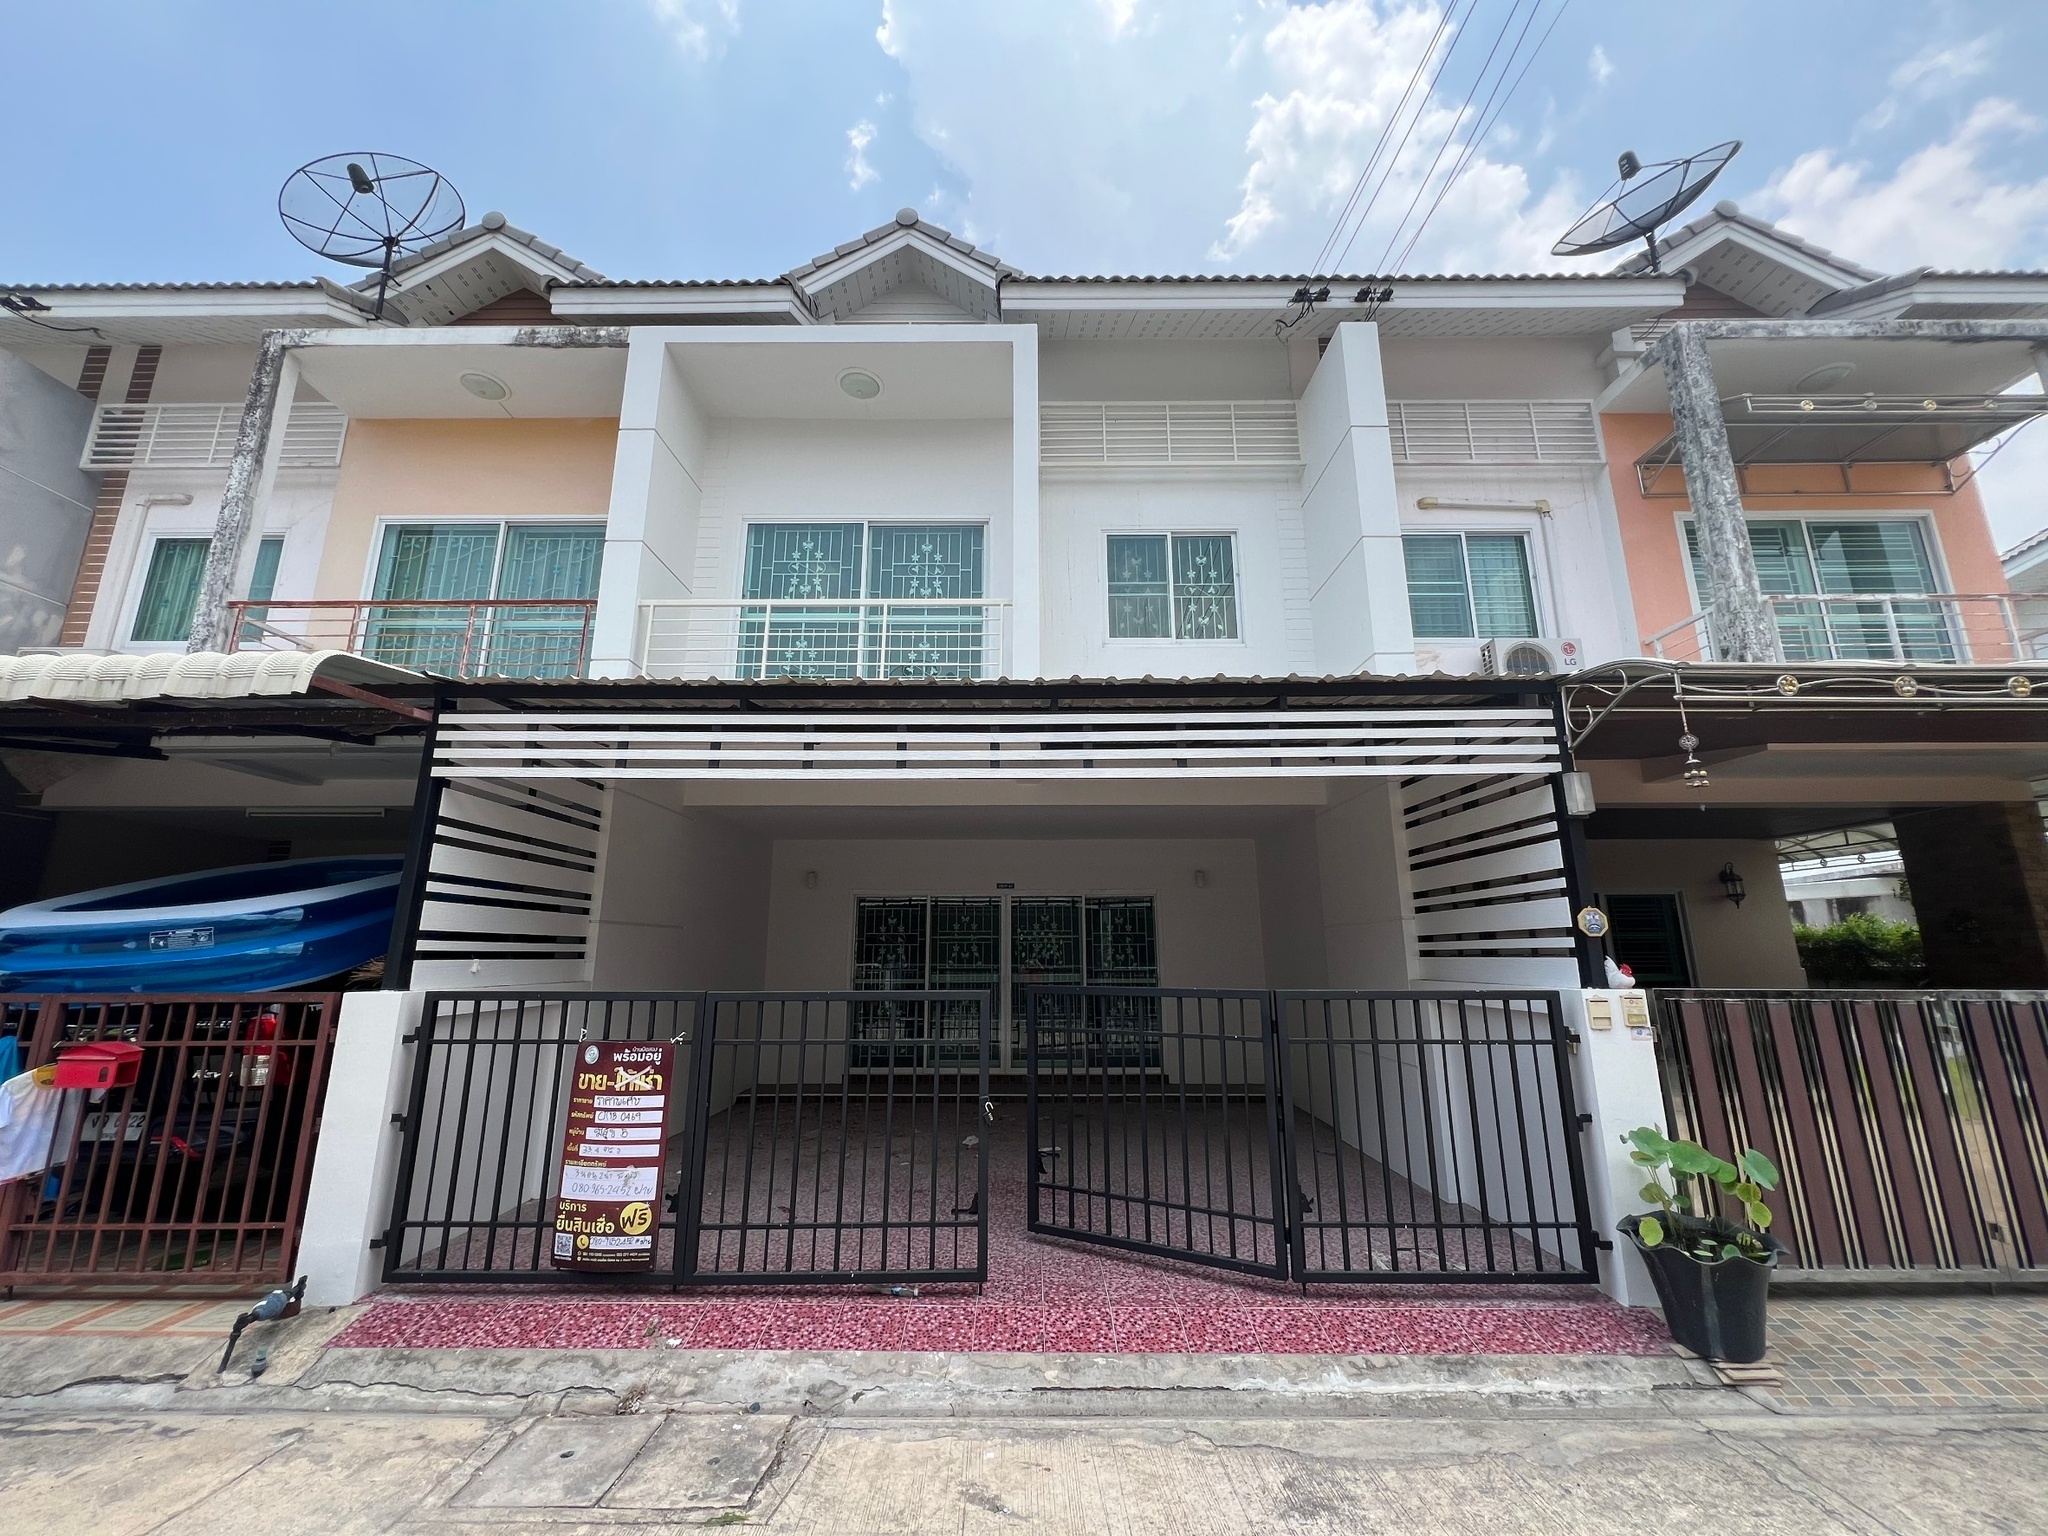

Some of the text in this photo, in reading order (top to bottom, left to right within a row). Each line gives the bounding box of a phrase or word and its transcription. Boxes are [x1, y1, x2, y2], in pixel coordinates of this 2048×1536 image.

[1564, 658, 1577, 666] LG
[613, 1048, 662, 1066] พร้อมอยู่
[559, 1199, 587, 1212] บริการ
[556, 1211, 615, 1234] ยื่นสินเชื่อ
[622, 1207, 649, 1230] ฟรี
